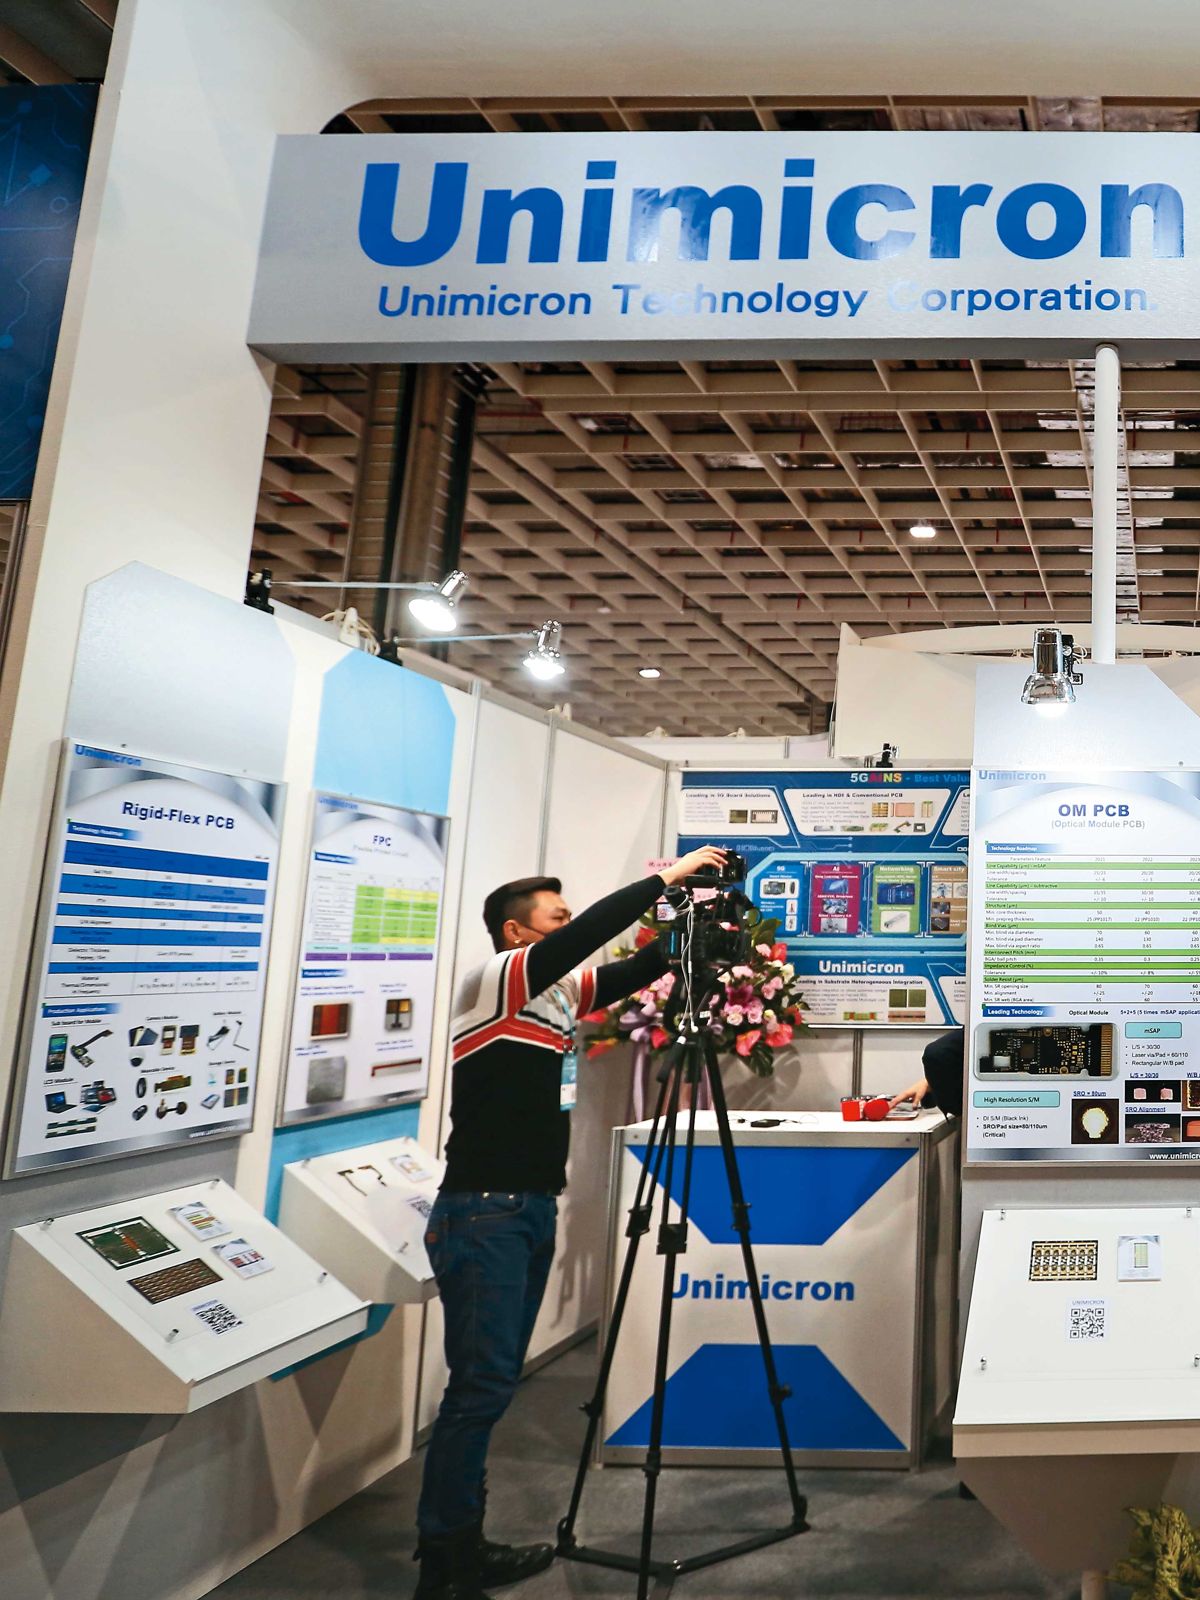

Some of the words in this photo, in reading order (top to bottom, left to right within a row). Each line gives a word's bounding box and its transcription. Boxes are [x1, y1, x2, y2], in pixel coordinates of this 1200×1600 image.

[357, 158, 1185, 267] Unimicron
[378, 284, 592, 318] Unimicron
[617, 282, 868, 318] Technology
[75, 744, 142, 768] Unimicron
[914, 773, 939, 783] Best
[978, 769, 1046, 781] Unimicron
[122, 801, 201, 826] Rigid-Flex
[205, 814, 235, 830] PCB
[1058, 804, 1087, 817] OM
[1093, 804, 1130, 817] PCB
[1051, 819, 1087, 829] (Optical
[1088, 819, 1121, 829] Module
[1122, 819, 1146, 829] PCB)
[373, 835, 392, 847] FPC
[819, 960, 904, 974] Unimicron
